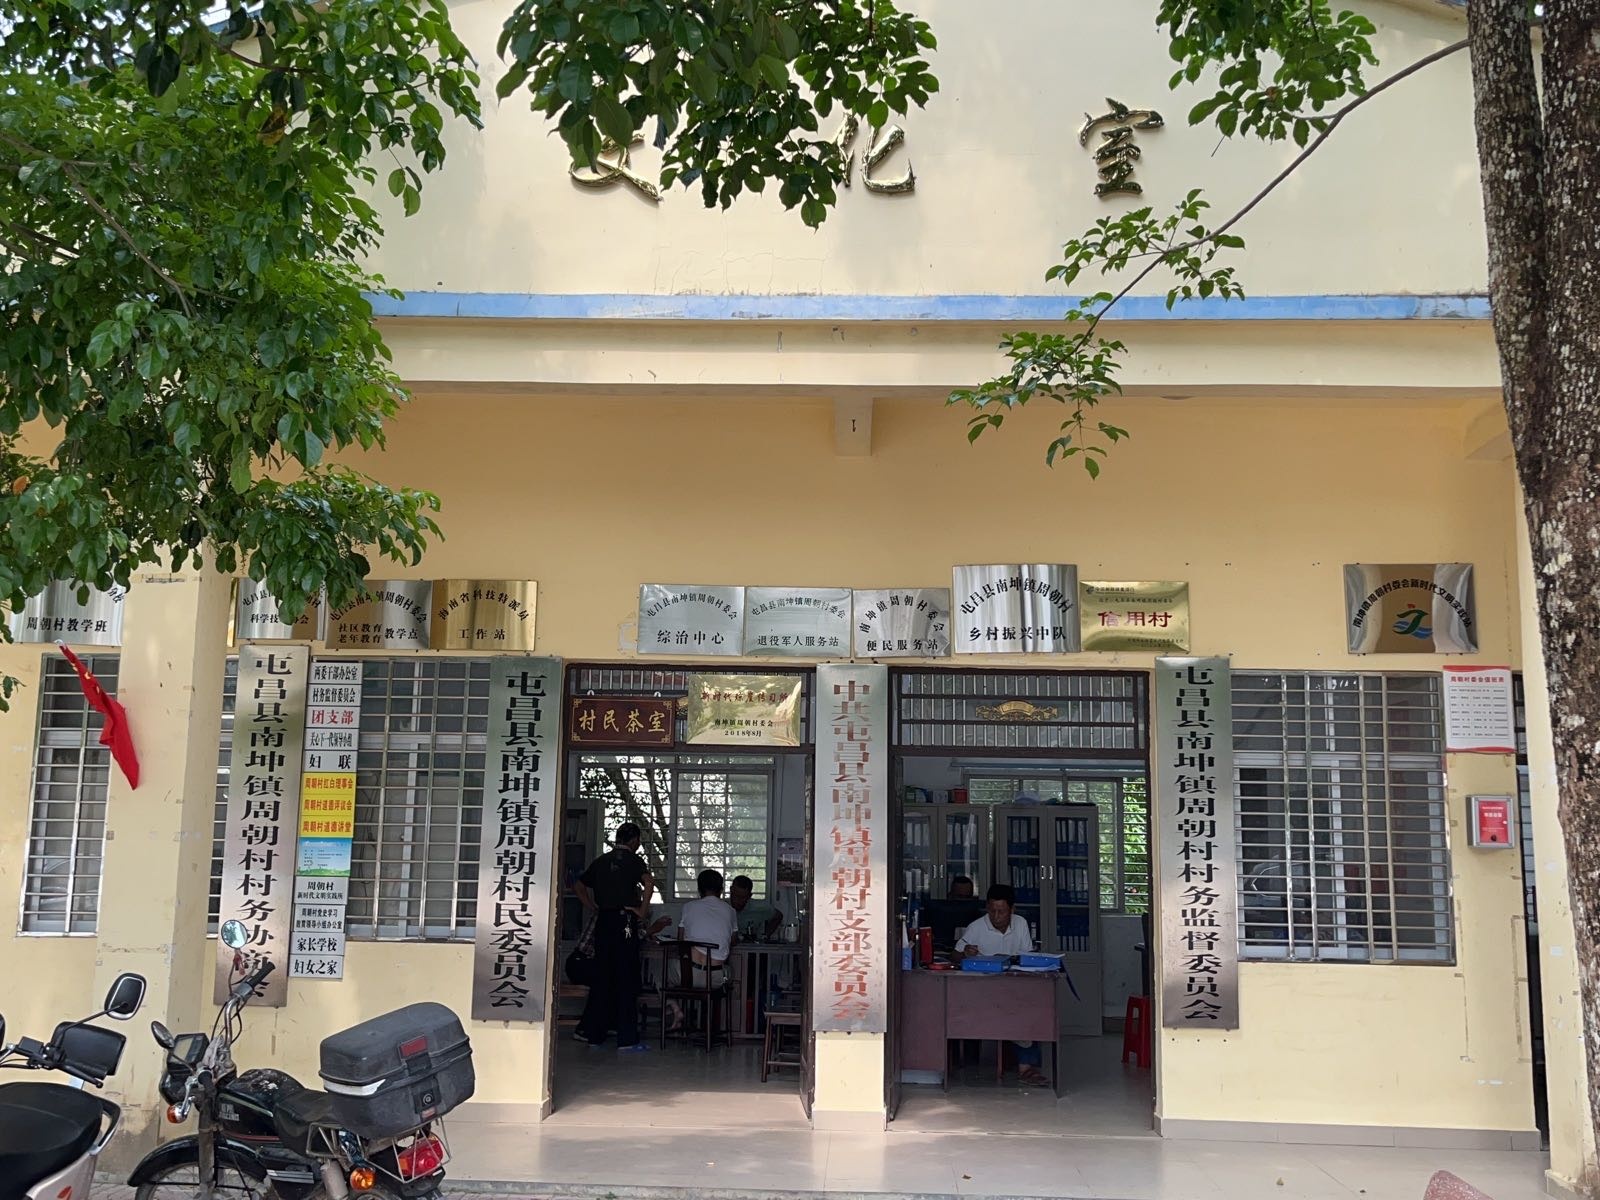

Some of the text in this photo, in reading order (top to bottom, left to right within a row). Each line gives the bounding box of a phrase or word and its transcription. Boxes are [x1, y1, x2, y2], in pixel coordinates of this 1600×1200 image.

[959, 577, 1074, 615] 屯昌县南坤镇周朝村
[438, 588, 530, 622] 海南省科技特派员
[647, 592, 738, 620] 屯昌县南坤镇周朝村委会
[751, 596, 847, 619] 屯昌县南坤镇周朝村委会
[250, 612, 309, 625] 科学技会
[858, 594, 946, 634] 南坤镇周朝村委会
[1096, 610, 1173, 628] 信用村
[26, 616, 109, 633] 周朝村教学班
[338, 623, 383, 633] 社区教育
[337, 633, 382, 644] 老年教育
[384, 627, 419, 640] 教学点
[458, 628, 507, 641] 工作站
[656, 629, 725, 646] 综治中心
[757, 635, 840, 648] 退役军人服务站
[969, 626, 1067, 642] 乡村振兴中队
[866, 638, 939, 652] 便民服务站
[313, 665, 358, 681] 两委干部办公室
[312, 687, 356, 703] 村务监督委员会
[311, 709, 354, 725] 团支部
[578, 708, 667, 734] 村民茶室
[714, 718, 774, 728] 南坤镇周朝村委会
[308, 753, 352, 770] 妇联
[304, 777, 354, 790] 周朝村红白理事会
[303, 799, 353, 812] 周朝村道德评议会
[302, 820, 352, 834] 周朝村道德讲堂
[489, 671, 548, 1009] 屯昌县南坤镇周朝村民委员会
[1173, 665, 1223, 1020] 屯昌县南坤镇周朝村村务监督委员会
[828, 679, 873, 1020] 中共屯昌县南坤镇周朝村支部委员会
[307, 881, 334, 891] 周朝村
[301, 907, 338, 918] 周朝村党史学习
[296, 937, 338, 952] 家长学校
[293, 959, 338, 975] 妇女之家
